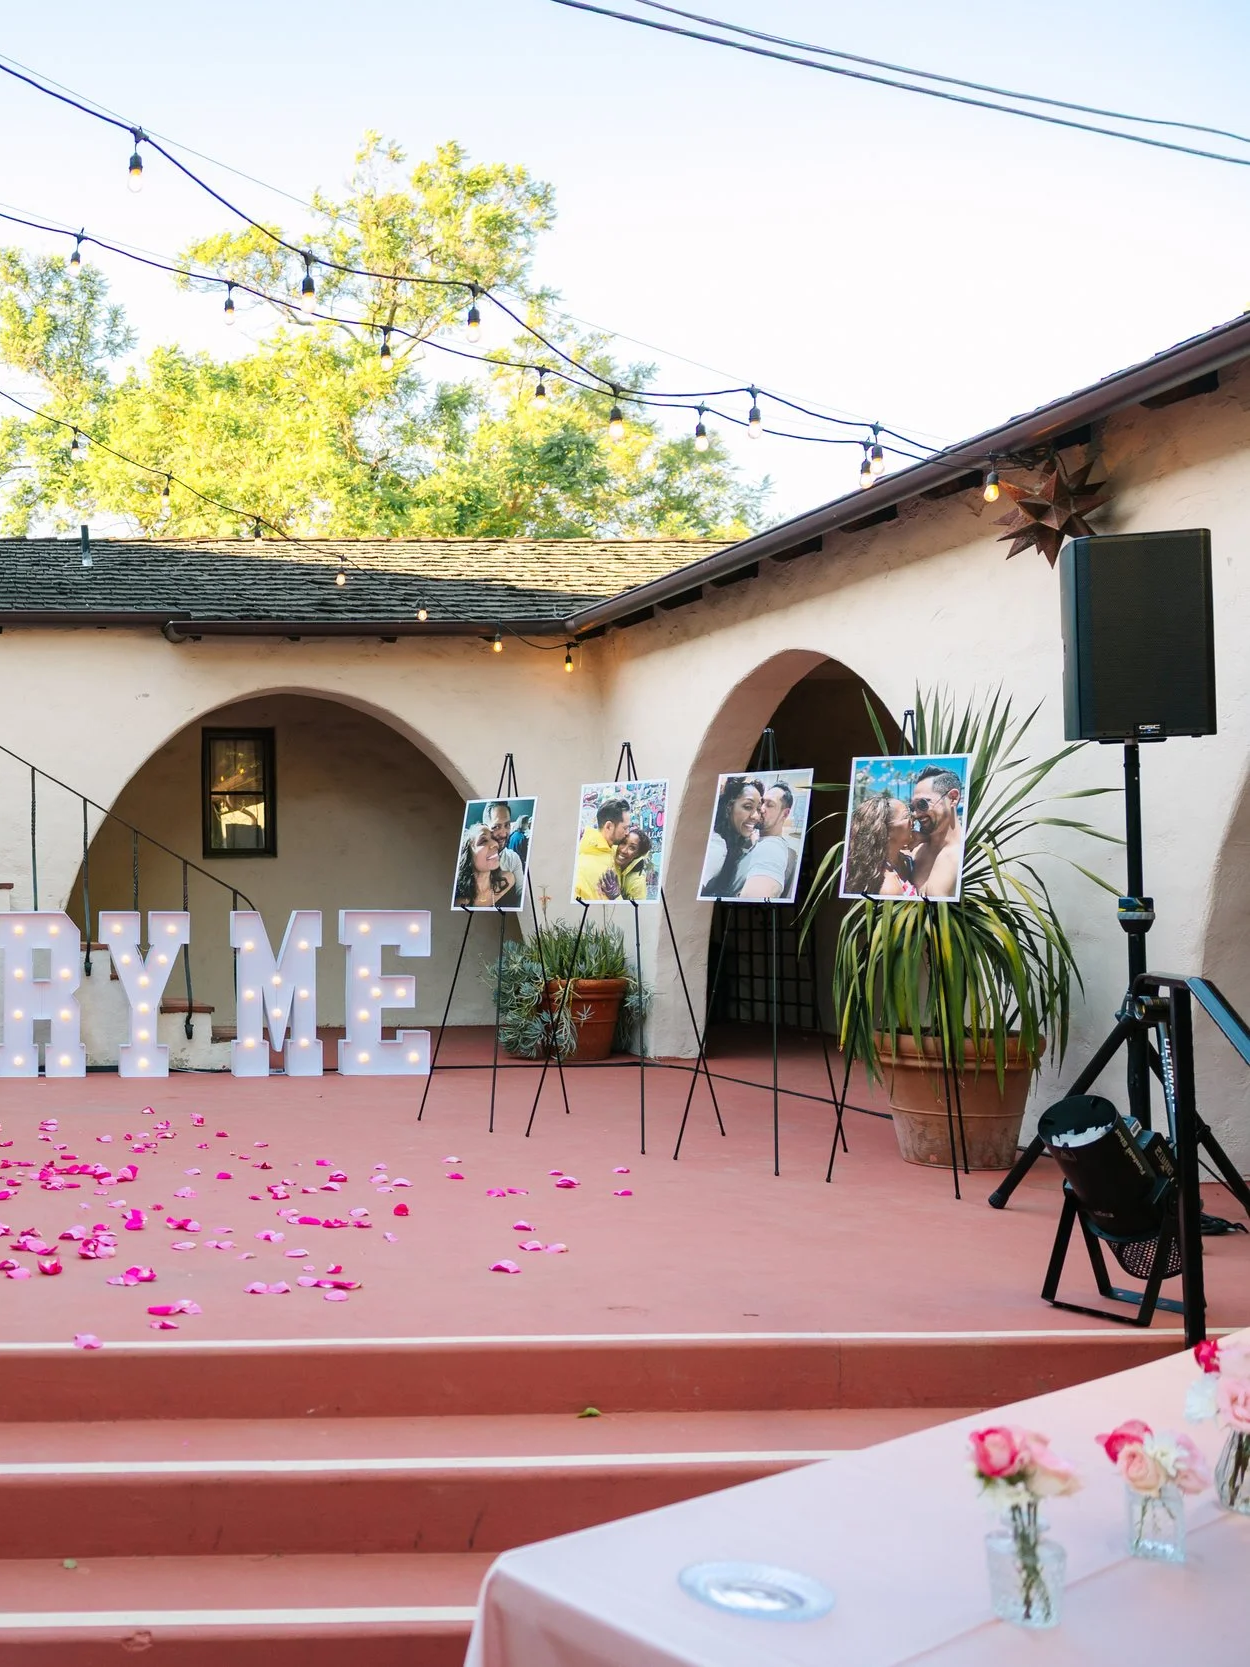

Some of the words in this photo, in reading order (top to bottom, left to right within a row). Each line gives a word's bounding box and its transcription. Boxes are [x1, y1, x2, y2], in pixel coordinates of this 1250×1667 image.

[229, 910, 432, 1077] ME
[1163, 1038, 1175, 1113] ULTIMA
[1124, 1146, 1146, 1176] Funfetti
